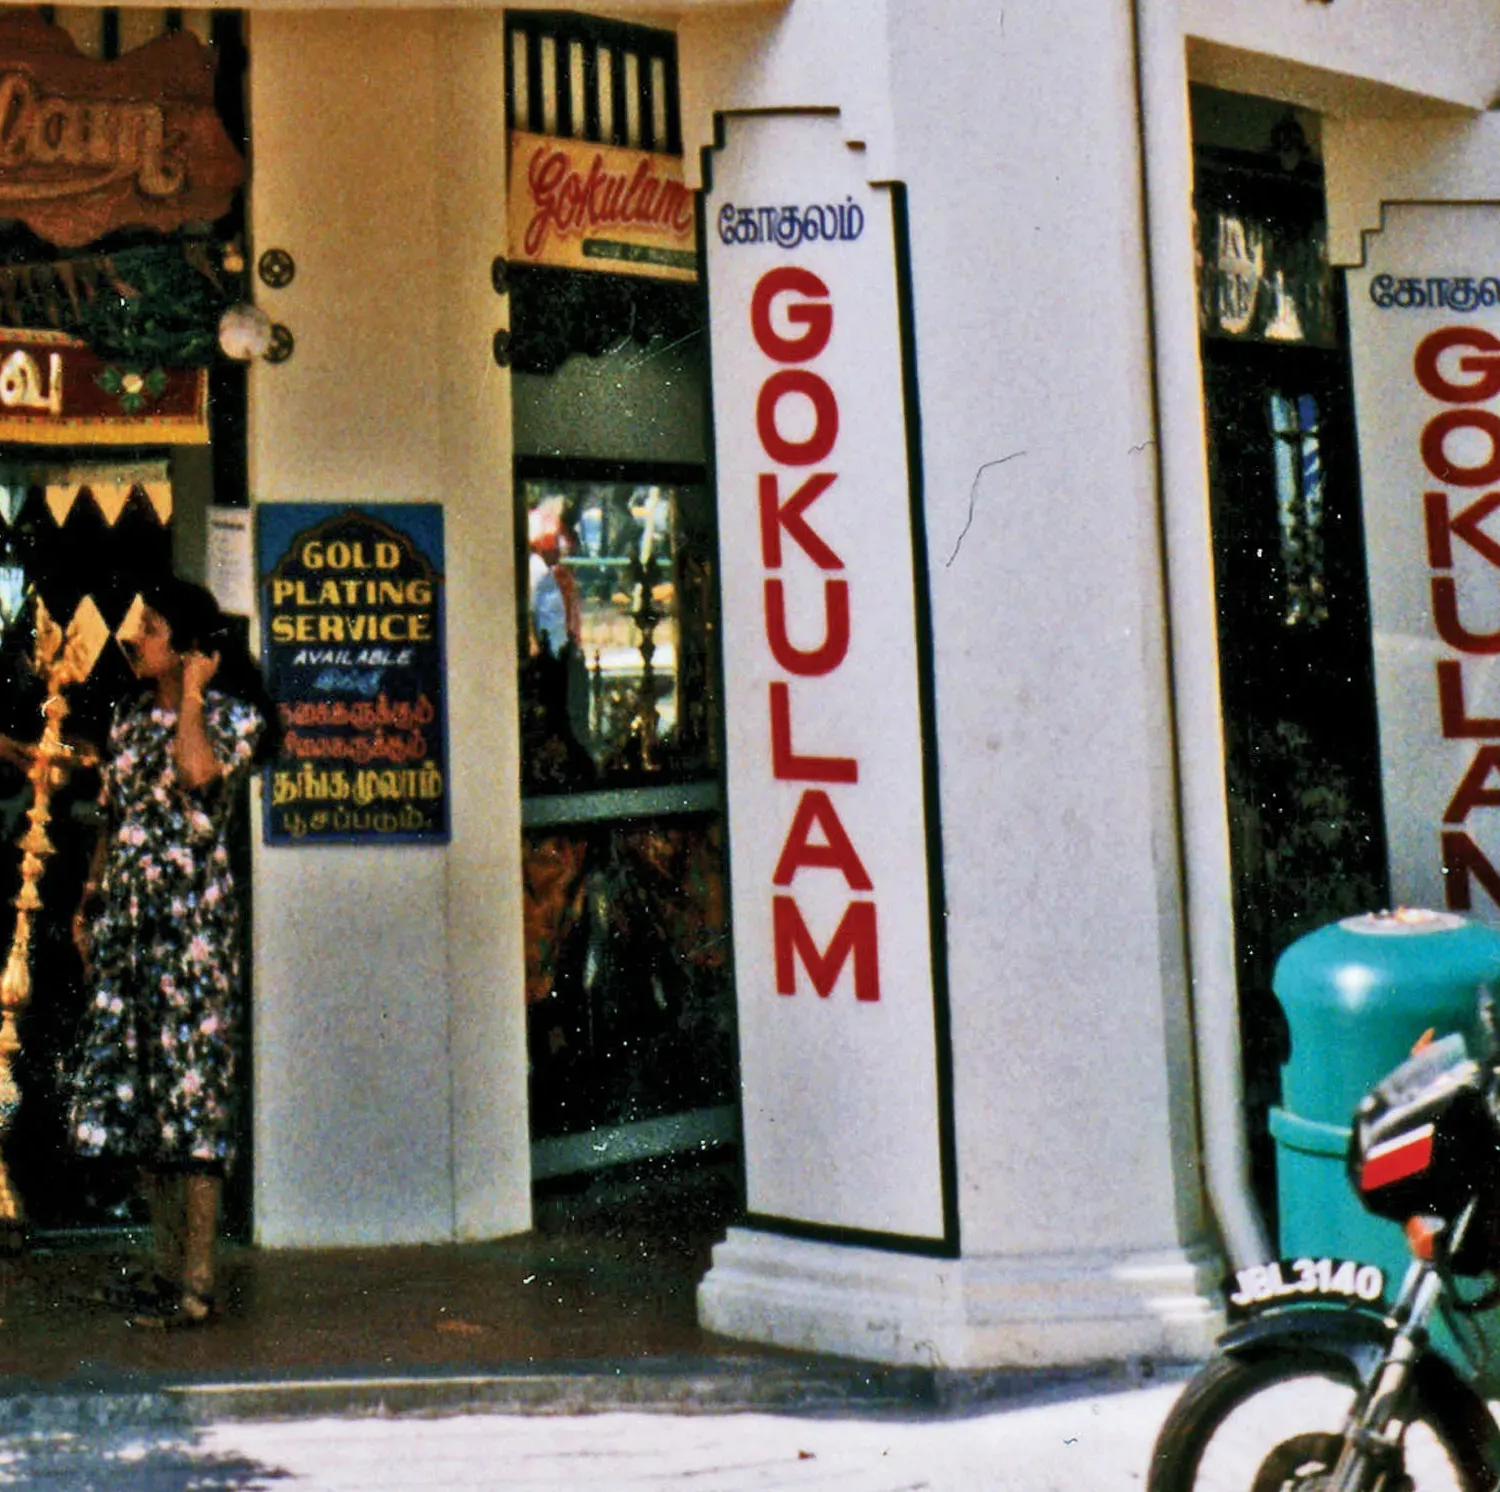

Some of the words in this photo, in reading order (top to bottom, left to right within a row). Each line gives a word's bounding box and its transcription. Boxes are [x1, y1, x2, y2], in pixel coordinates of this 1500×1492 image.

[525, 147, 692, 256] Gokulam
[717, 194, 866, 250] கோகுலம்
[302, 540, 401, 569] GOLD
[273, 579, 432, 606] PLATING
[272, 614, 432, 642] SERVICE
[750, 265, 881, 1002] GOKULAM
[292, 648, 412, 666] AVAILABLE
